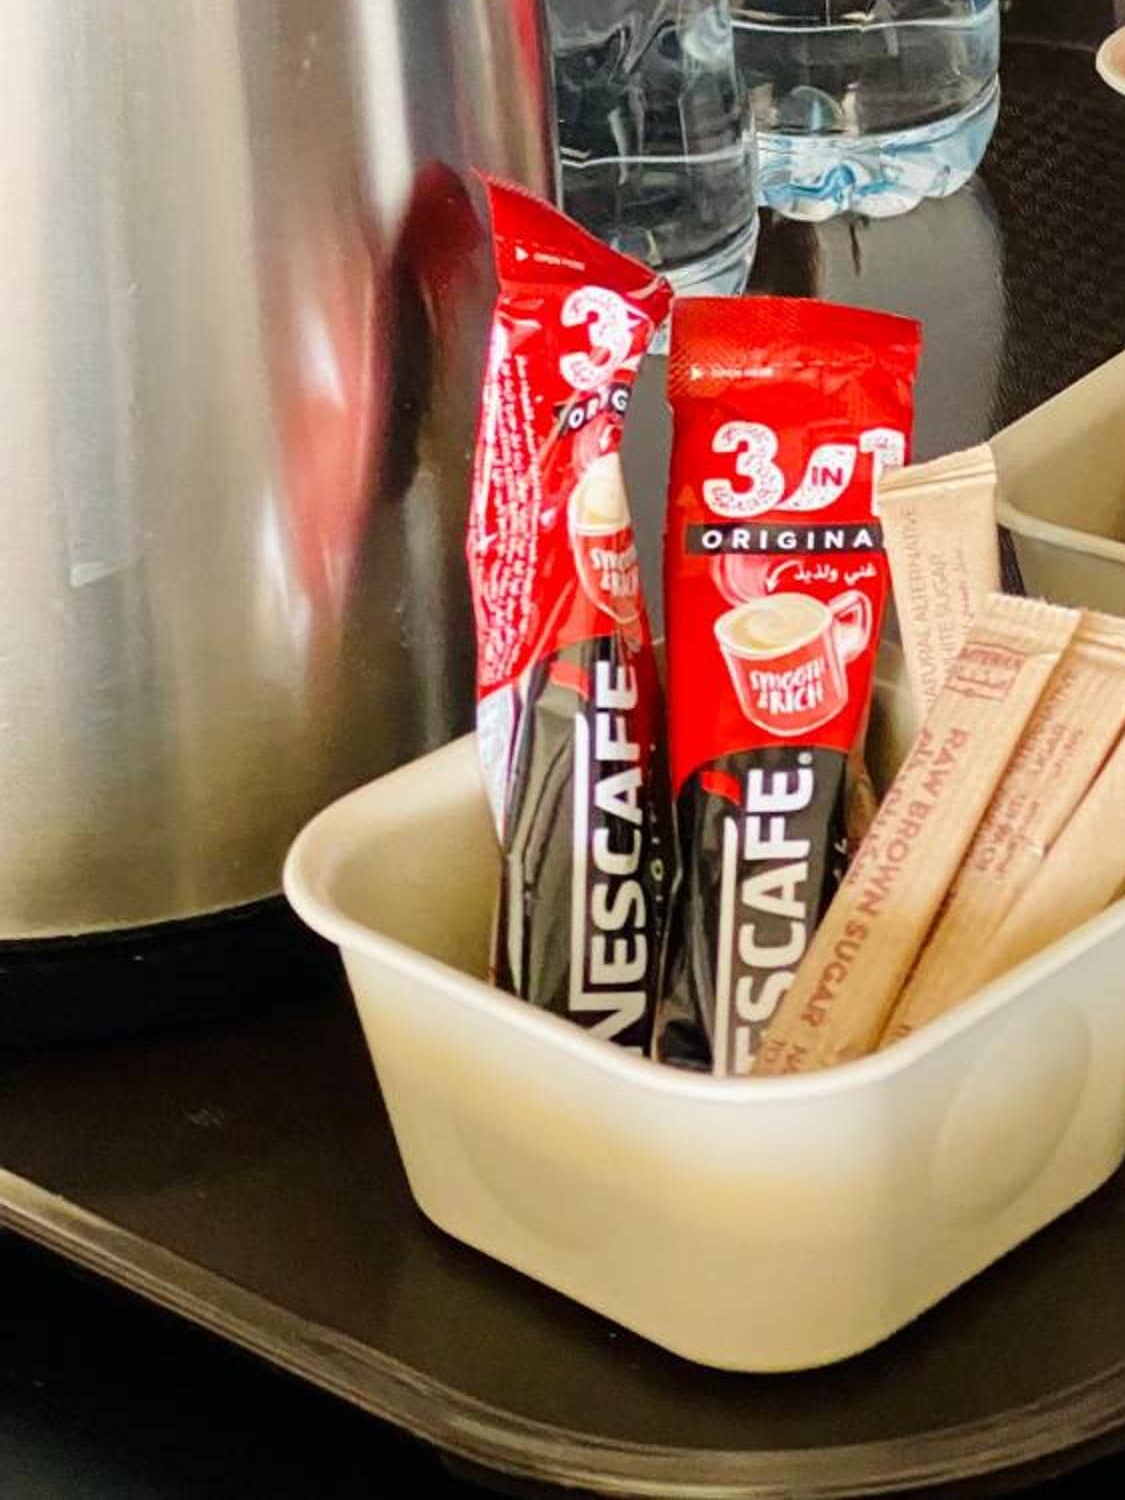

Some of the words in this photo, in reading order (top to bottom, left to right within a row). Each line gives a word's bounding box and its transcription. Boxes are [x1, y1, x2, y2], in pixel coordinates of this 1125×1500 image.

[703, 420, 785, 518] 3
[811, 466, 843, 486] IN
[702, 528, 874, 550] ORIGINA
[928, 727, 969, 795] RAW
[859, 792, 932, 918] BROWN
[800, 917, 871, 1030] SUGAR
